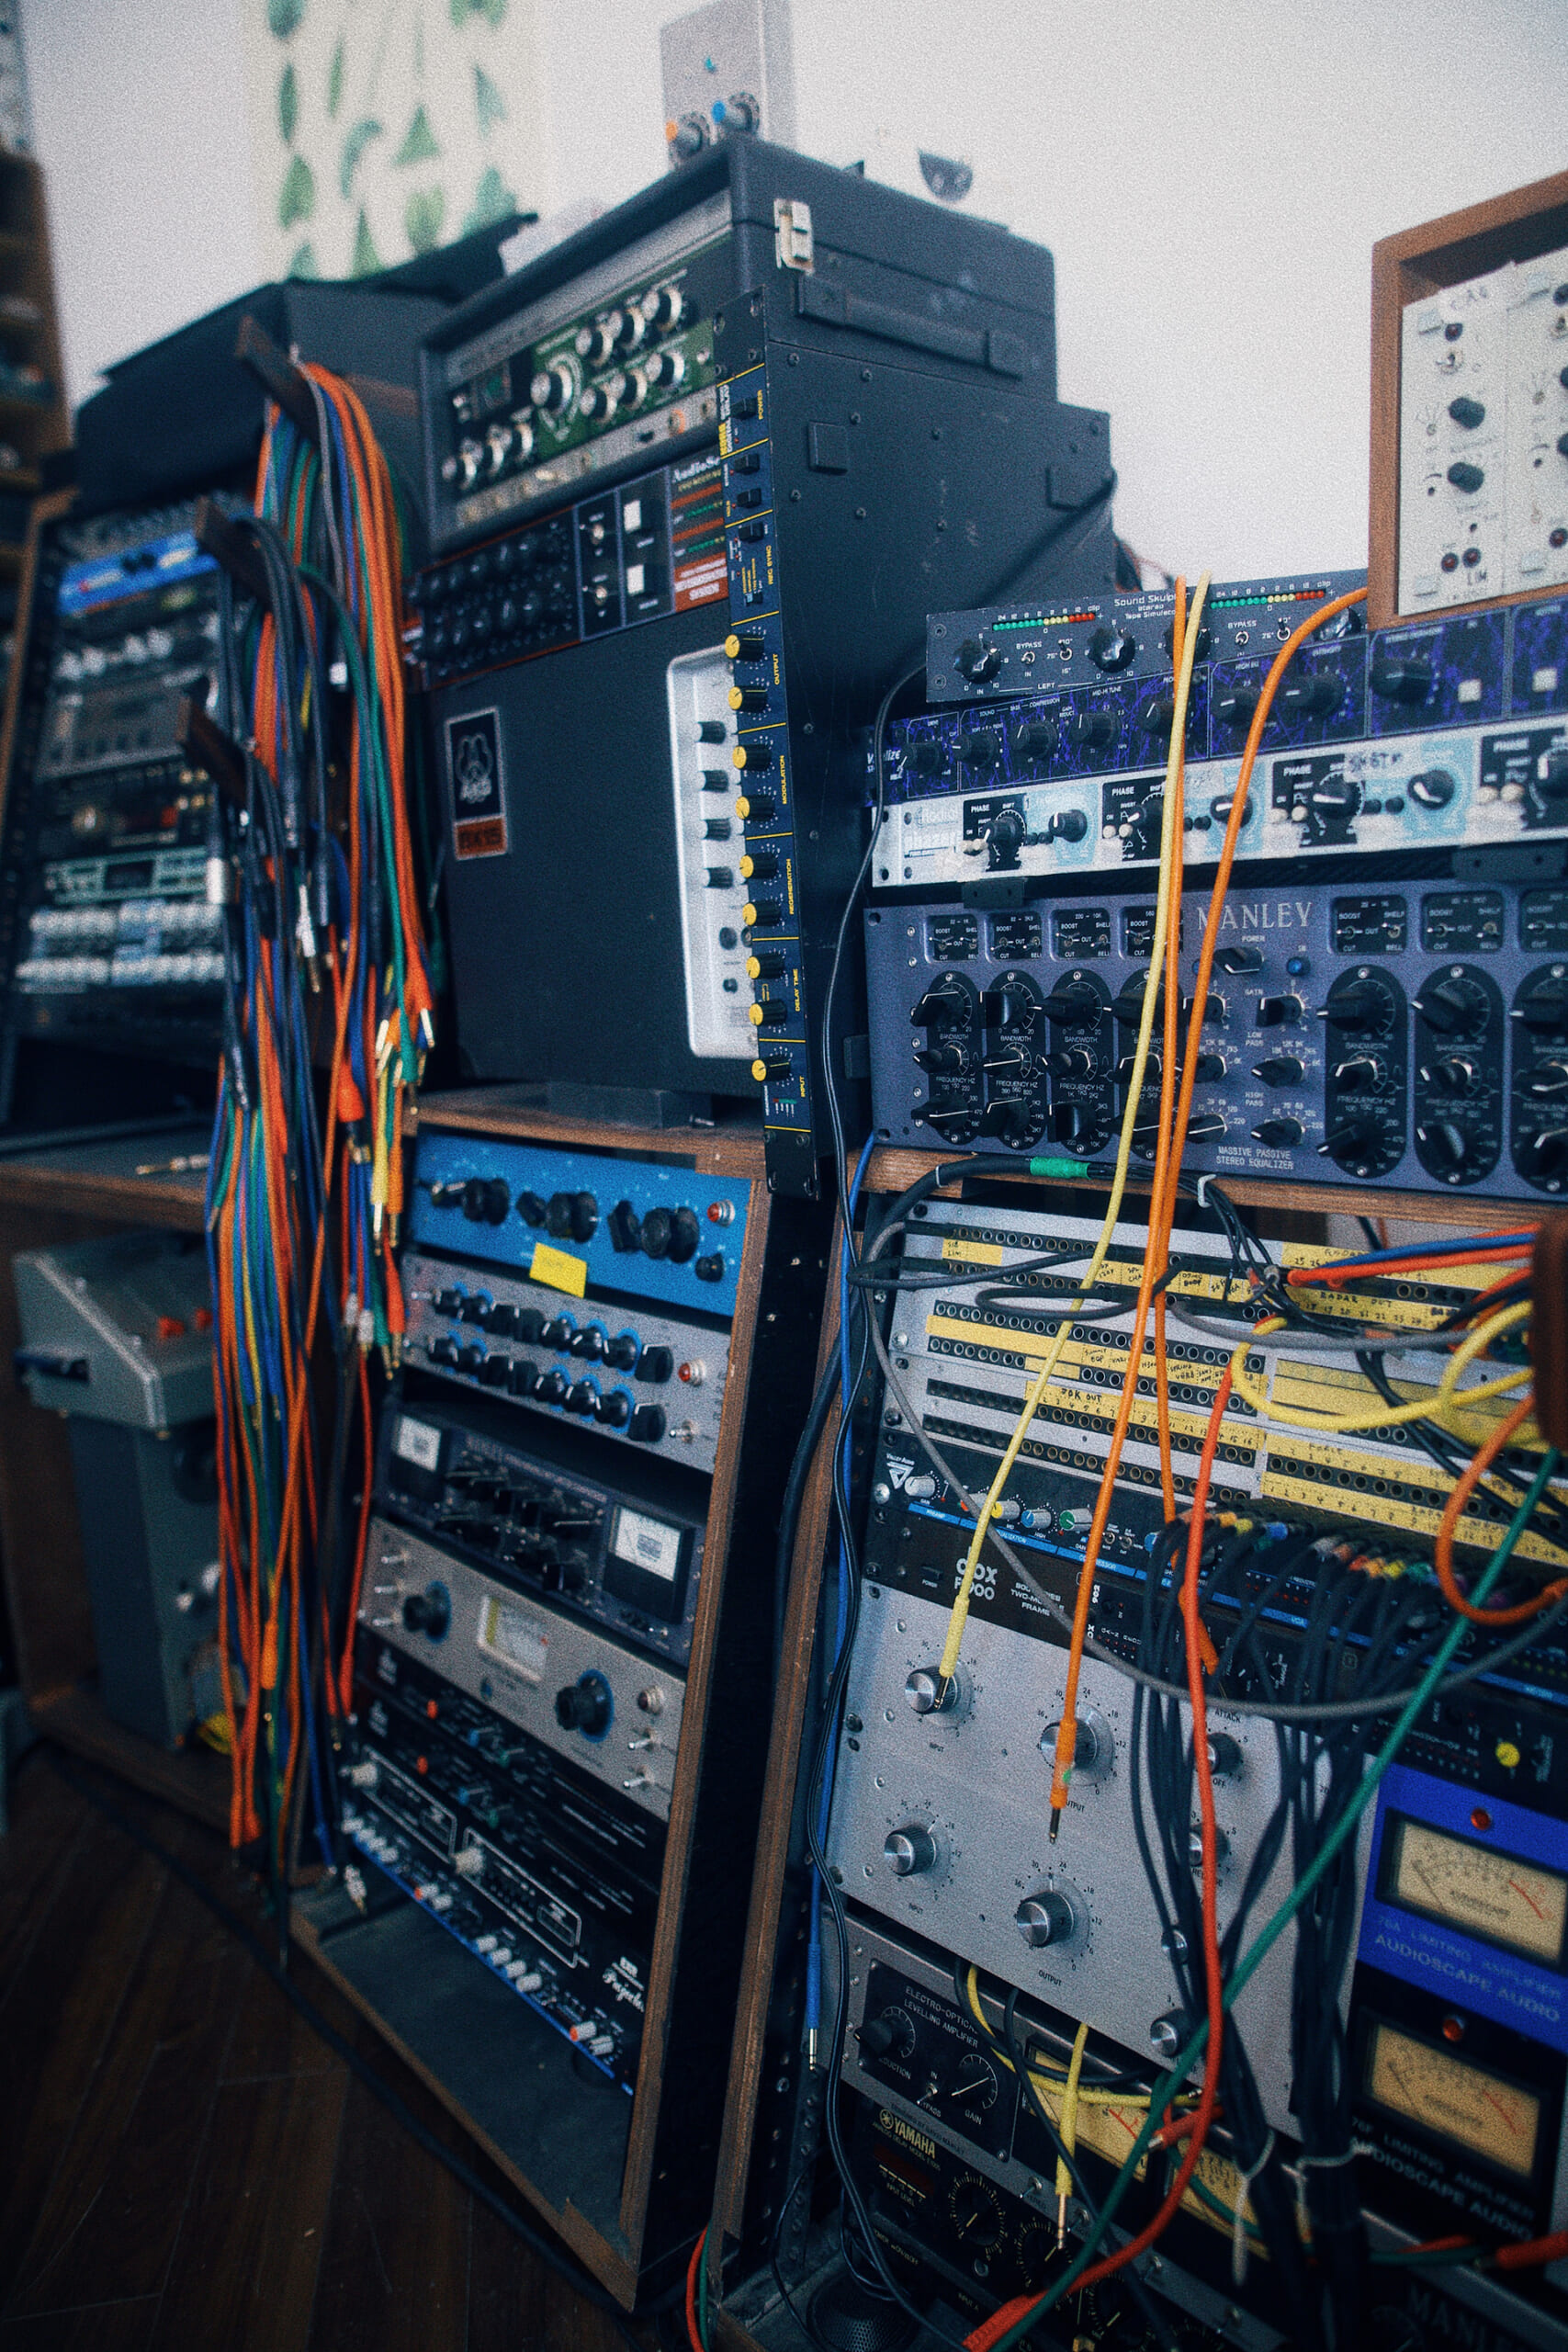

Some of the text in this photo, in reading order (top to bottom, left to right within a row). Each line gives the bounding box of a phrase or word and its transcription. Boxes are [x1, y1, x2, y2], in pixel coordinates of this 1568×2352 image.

[765, 545, 773, 568] SYNC
[1316, 580, 1331, 589] clip
[1113, 596, 1145, 607] Sound
[1088, 604, 1100, 614] clip
[1124, 611, 1142, 620] Tape
[1227, 619, 1258, 629] BYPASS
[1016, 640, 1043, 650] BYPASS
[772, 653, 781, 685] OUTPUT
[1493, 737, 1530, 754] PHASE
[1282, 763, 1313, 777] PHASE
[779, 754, 787, 805] MODULATION
[1111, 786, 1135, 797] PHASE
[970, 804, 991, 813] PHASE
[1120, 801, 1136, 809] INVERT
[785, 858, 795, 915] REGENERATION
[1196, 901, 1313, 931] MANLEY
[1382, 910, 1406, 919] SHELF
[1364, 927, 1379, 935] OUT
[1342, 944, 1357, 953] CUT
[1385, 943, 1404, 952] BELL
[793, 989, 801, 1012] DELAY
[1064, 1035, 1099, 1044] BANDWIDTH
[1247, 1031, 1263, 1039] LOW
[1245, 1039, 1265, 1047] PASS
[995, 1080, 1029, 1089] FREQUENCY
[1059, 1082, 1095, 1091] FREQUENCY
[1245, 1099, 1265, 1107] PASS
[1218, 1146, 1292, 1160] MASSIVE PASSIVE
[1215, 1155, 1295, 1170] STEREO EQUALIZER
[1320, 1291, 1359, 1304] RADAR
[1086, 1395, 1103, 1404] OUT
[1034, 1532, 1047, 1540] HIGH
[921, 1578, 939, 1589] POWER
[1091, 1584, 1101, 1604] 902
[1021, 1601, 1051, 1618] FRAME
[1055, 1689, 1063, 1698] 30
[1083, 1687, 1091, 1696] 24
[1037, 1709, 1045, 1718] 36
[1111, 1709, 1120, 1719] 18
[1214, 1707, 1242, 1724] ATTACK
[1119, 1739, 1127, 1749] 12
[1213, 1777, 1226, 1790] OFF
[1066, 1800, 1086, 1814] UTPUT
[1032, 1860, 1040, 1869] 30
[1059, 1860, 1068, 1870] 24
[1087, 1885, 1096, 1895] 18
[1094, 1916, 1103, 1927] 12
[1410, 1930, 1472, 1962] LIMITING
[1038, 1969, 1063, 1987] OUTPUT
[1375, 1934, 1561, 2023] AUDIOSCAPE AUDIO
[905, 1984, 979, 2036] ELECTRO-OPTICA
[904, 1998, 979, 2050] LEVELLING AMPLIFIER
[931, 2070, 939, 2081] IN
[920, 2100, 942, 2119] YPASS
[964, 2109, 983, 2126] GAIN
[894, 2116, 937, 2160] YAMAHA
[1382, 2132, 1446, 2175] LIMITING
[1453, 2171, 1537, 2222] AMPLIFIER
[1469, 2200, 1533, 2242] AUDIO
